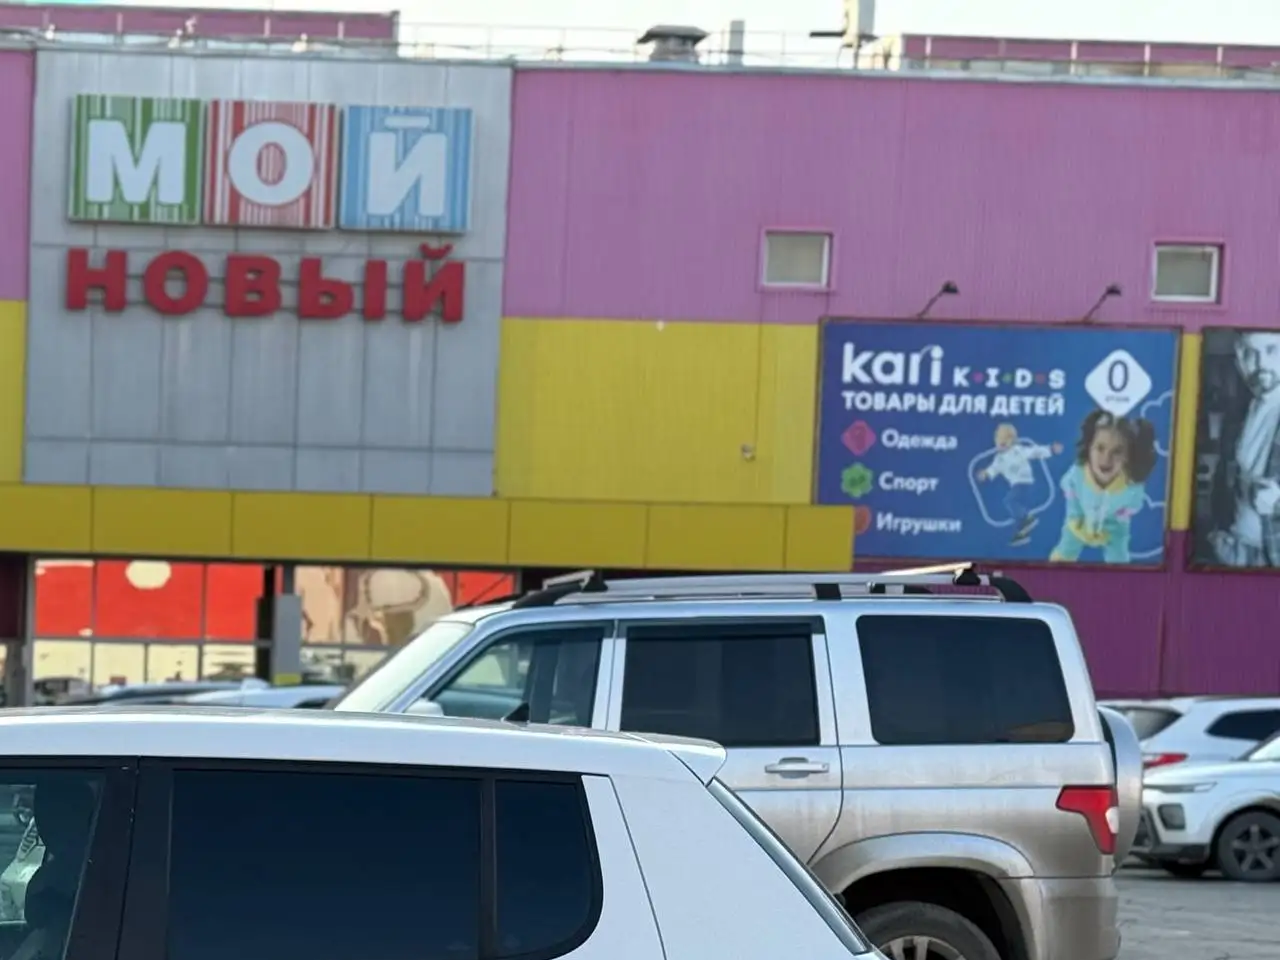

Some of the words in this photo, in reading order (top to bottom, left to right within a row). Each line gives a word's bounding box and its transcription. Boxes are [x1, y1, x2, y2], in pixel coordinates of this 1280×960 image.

[85, 115, 449, 217] МОЙ
[65, 243, 467, 323] НОВЫЙ
[842, 341, 944, 386] kari
[841, 390, 935, 412] ТОВАРЫ
[938, 394, 987, 416] ДЛЯ
[990, 392, 1065, 417] ДЕТЕЙ
[881, 428, 958, 450] Одежда
[878, 471, 939, 495] Спорт
[876, 511, 962, 535] Игрушки
